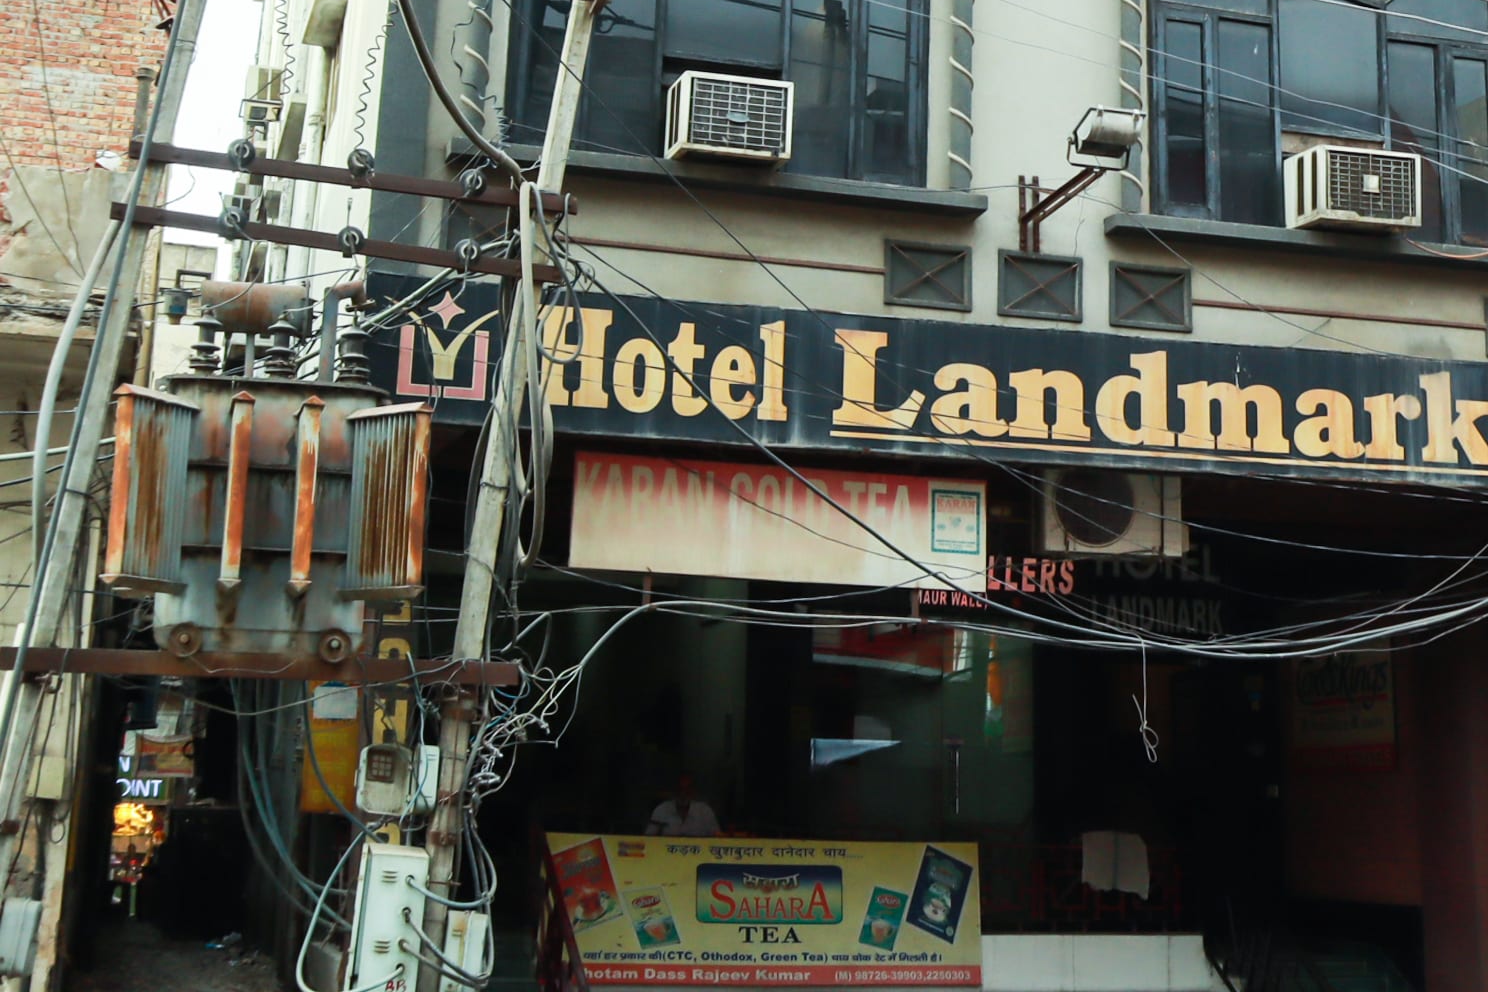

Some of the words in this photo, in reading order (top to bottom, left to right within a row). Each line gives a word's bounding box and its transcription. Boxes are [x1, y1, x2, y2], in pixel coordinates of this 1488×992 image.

[537, 304, 788, 423] Hotel
[577, 460, 714, 530] KARAN
[729, 471, 831, 534] GOLD
[843, 481, 913, 537] TEA
[710, 879, 834, 920] SAHARA
[739, 926, 802, 944] TEA
[701, 951, 757, 963] Othodox,
[761, 952, 797, 962] Green
[801, 952, 828, 964] Tea)
[644, 968, 687, 981] Dass
[692, 969, 750, 984] Rajeev
[755, 969, 812, 982] Kumar
[834, 970, 852, 982] (M)
